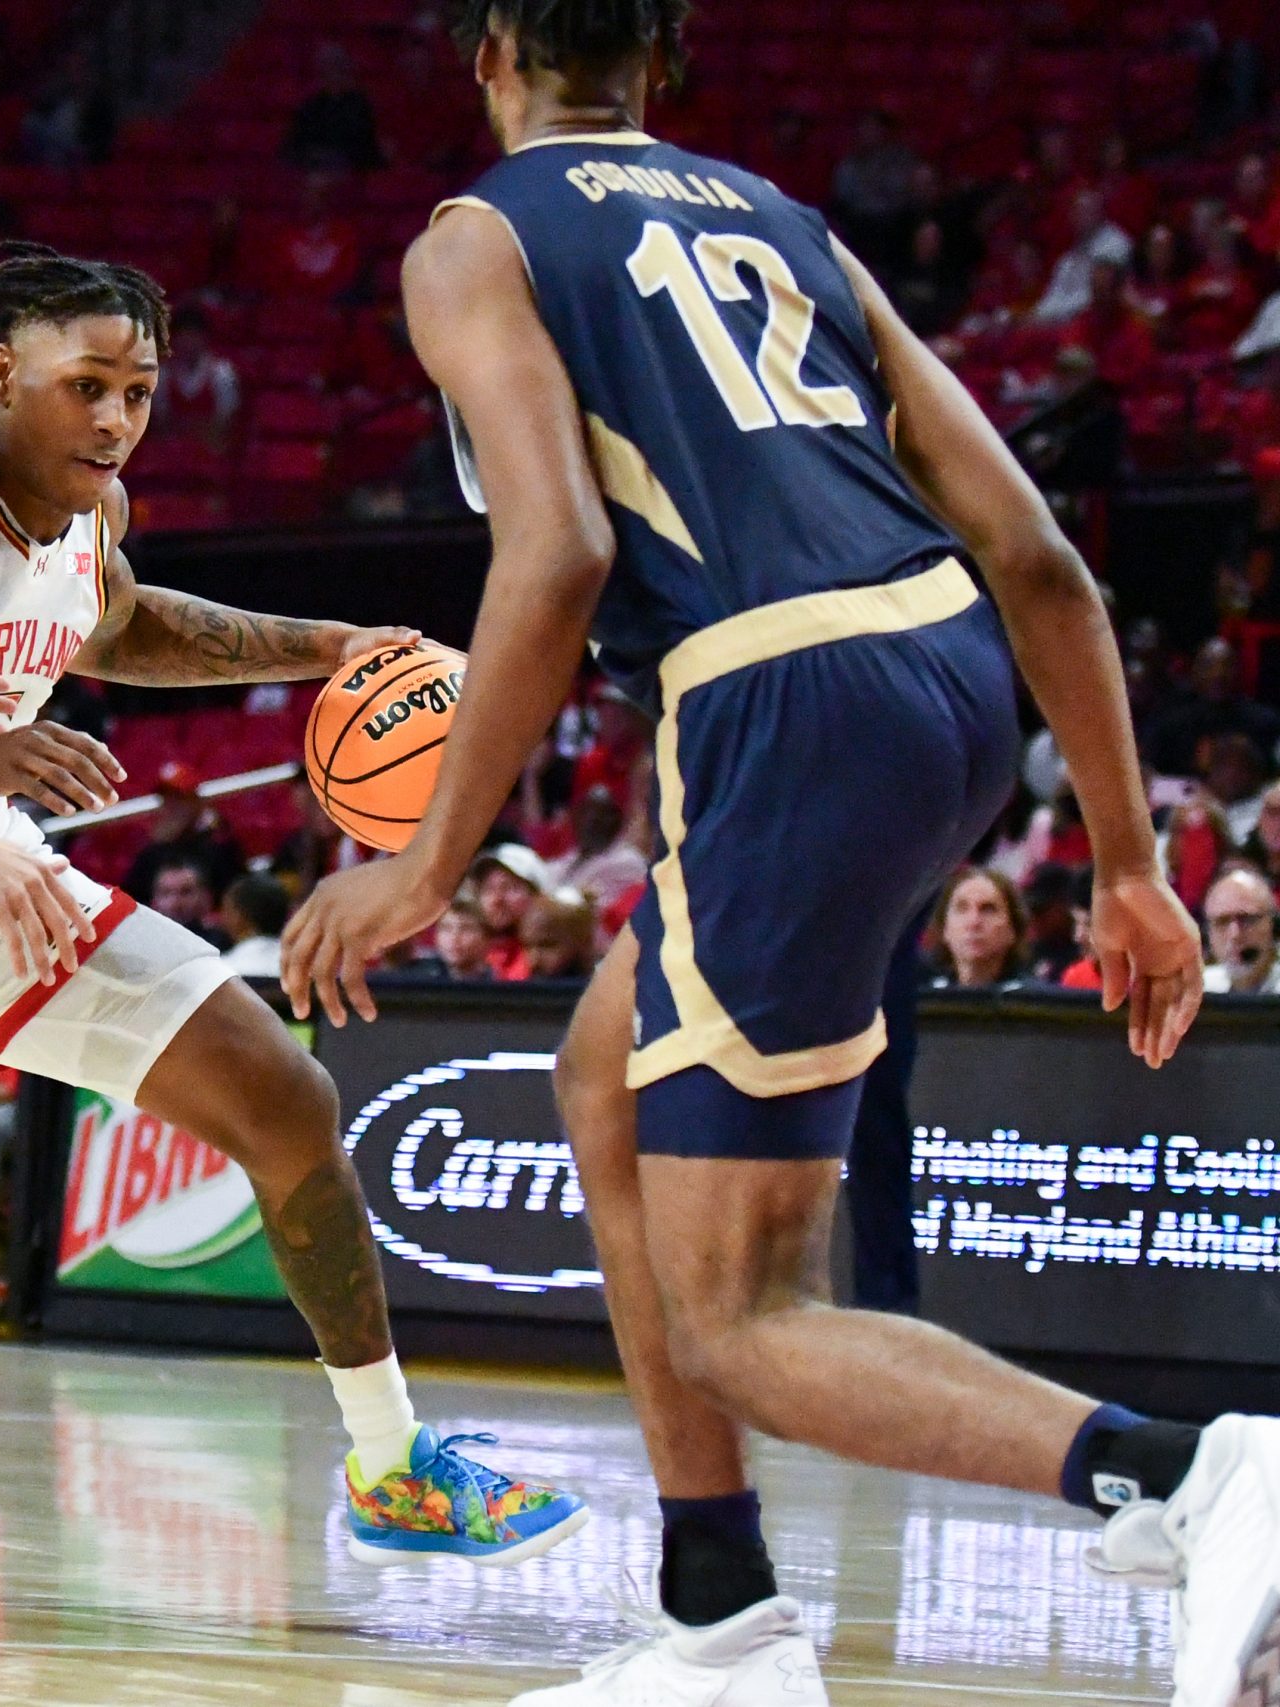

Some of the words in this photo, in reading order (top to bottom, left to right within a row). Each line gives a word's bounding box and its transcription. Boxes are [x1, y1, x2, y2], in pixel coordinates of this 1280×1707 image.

[624, 219, 868, 432] 12
[1072, 1133, 1158, 1192] and
[1163, 1135, 1280, 1197] Cooli
[948, 1196, 1144, 1273] Maryland
